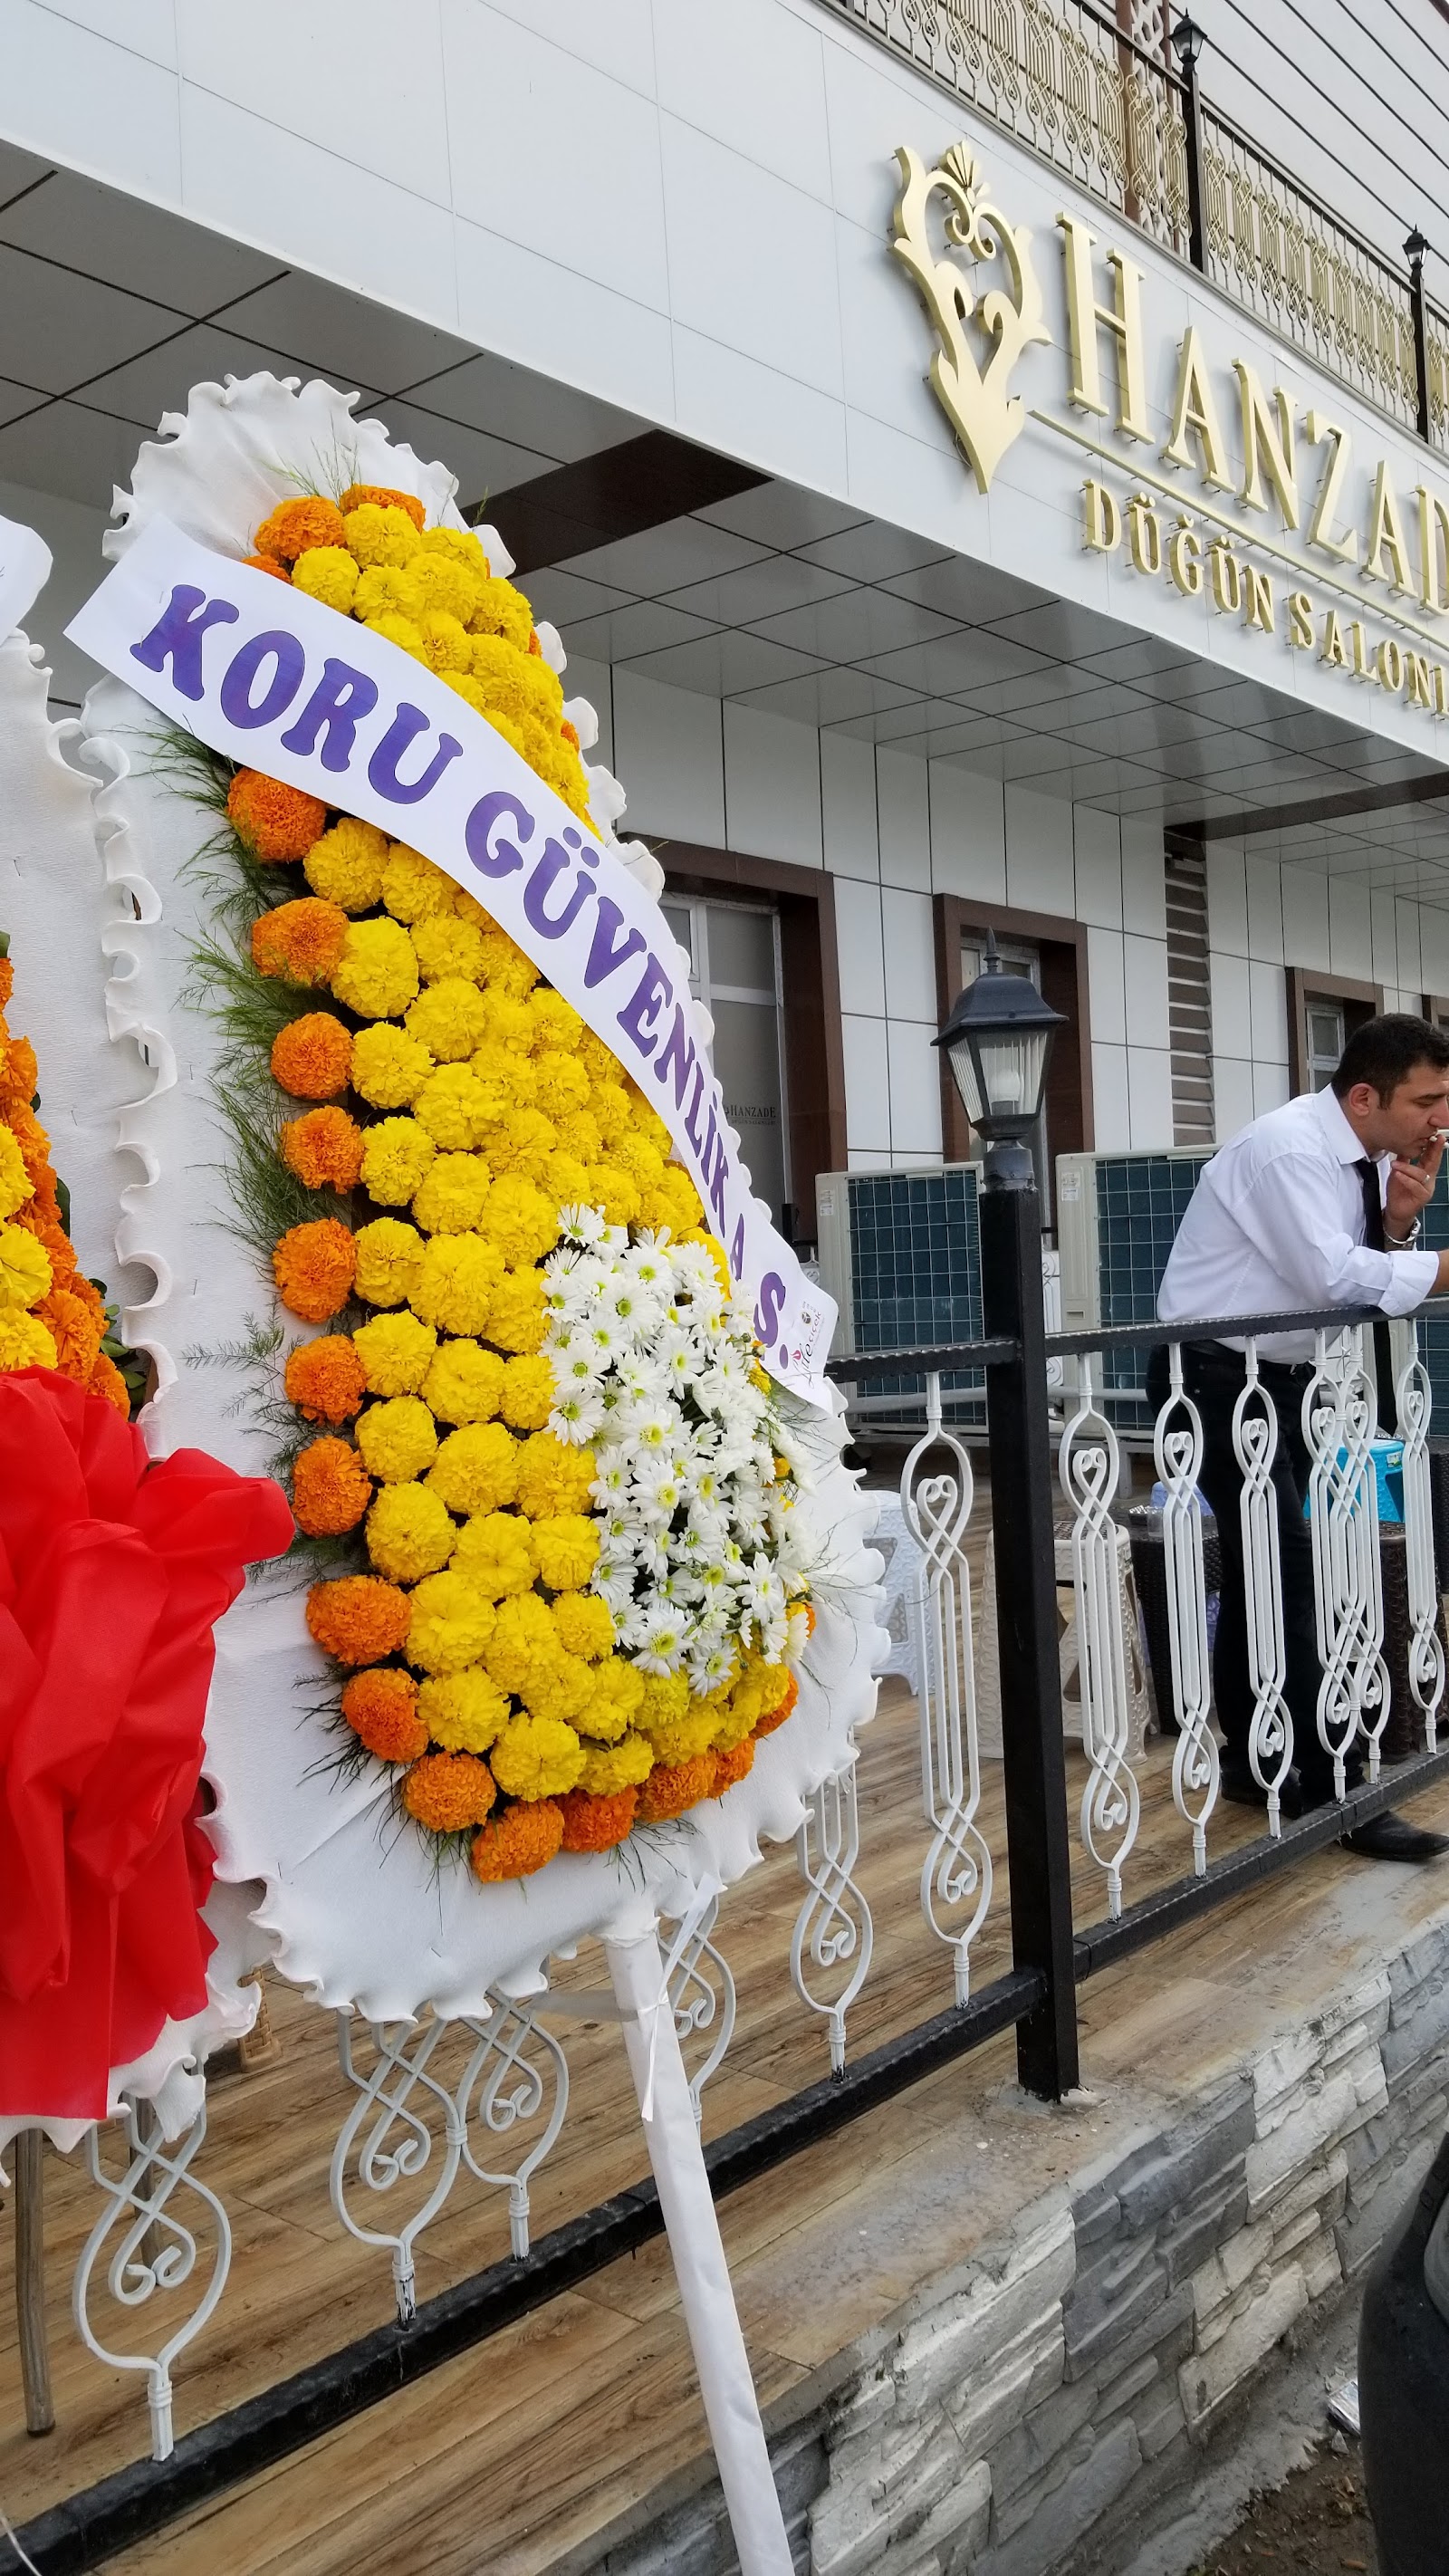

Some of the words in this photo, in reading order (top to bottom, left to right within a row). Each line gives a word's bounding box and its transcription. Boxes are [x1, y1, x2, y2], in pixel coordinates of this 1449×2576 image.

[1082, 478, 1275, 634] DÜĞÜN
[130, 583, 464, 805] KORU
[465, 791, 729, 1239] GÜVENLİK
[730, 1104, 776, 1118] HANZADE
